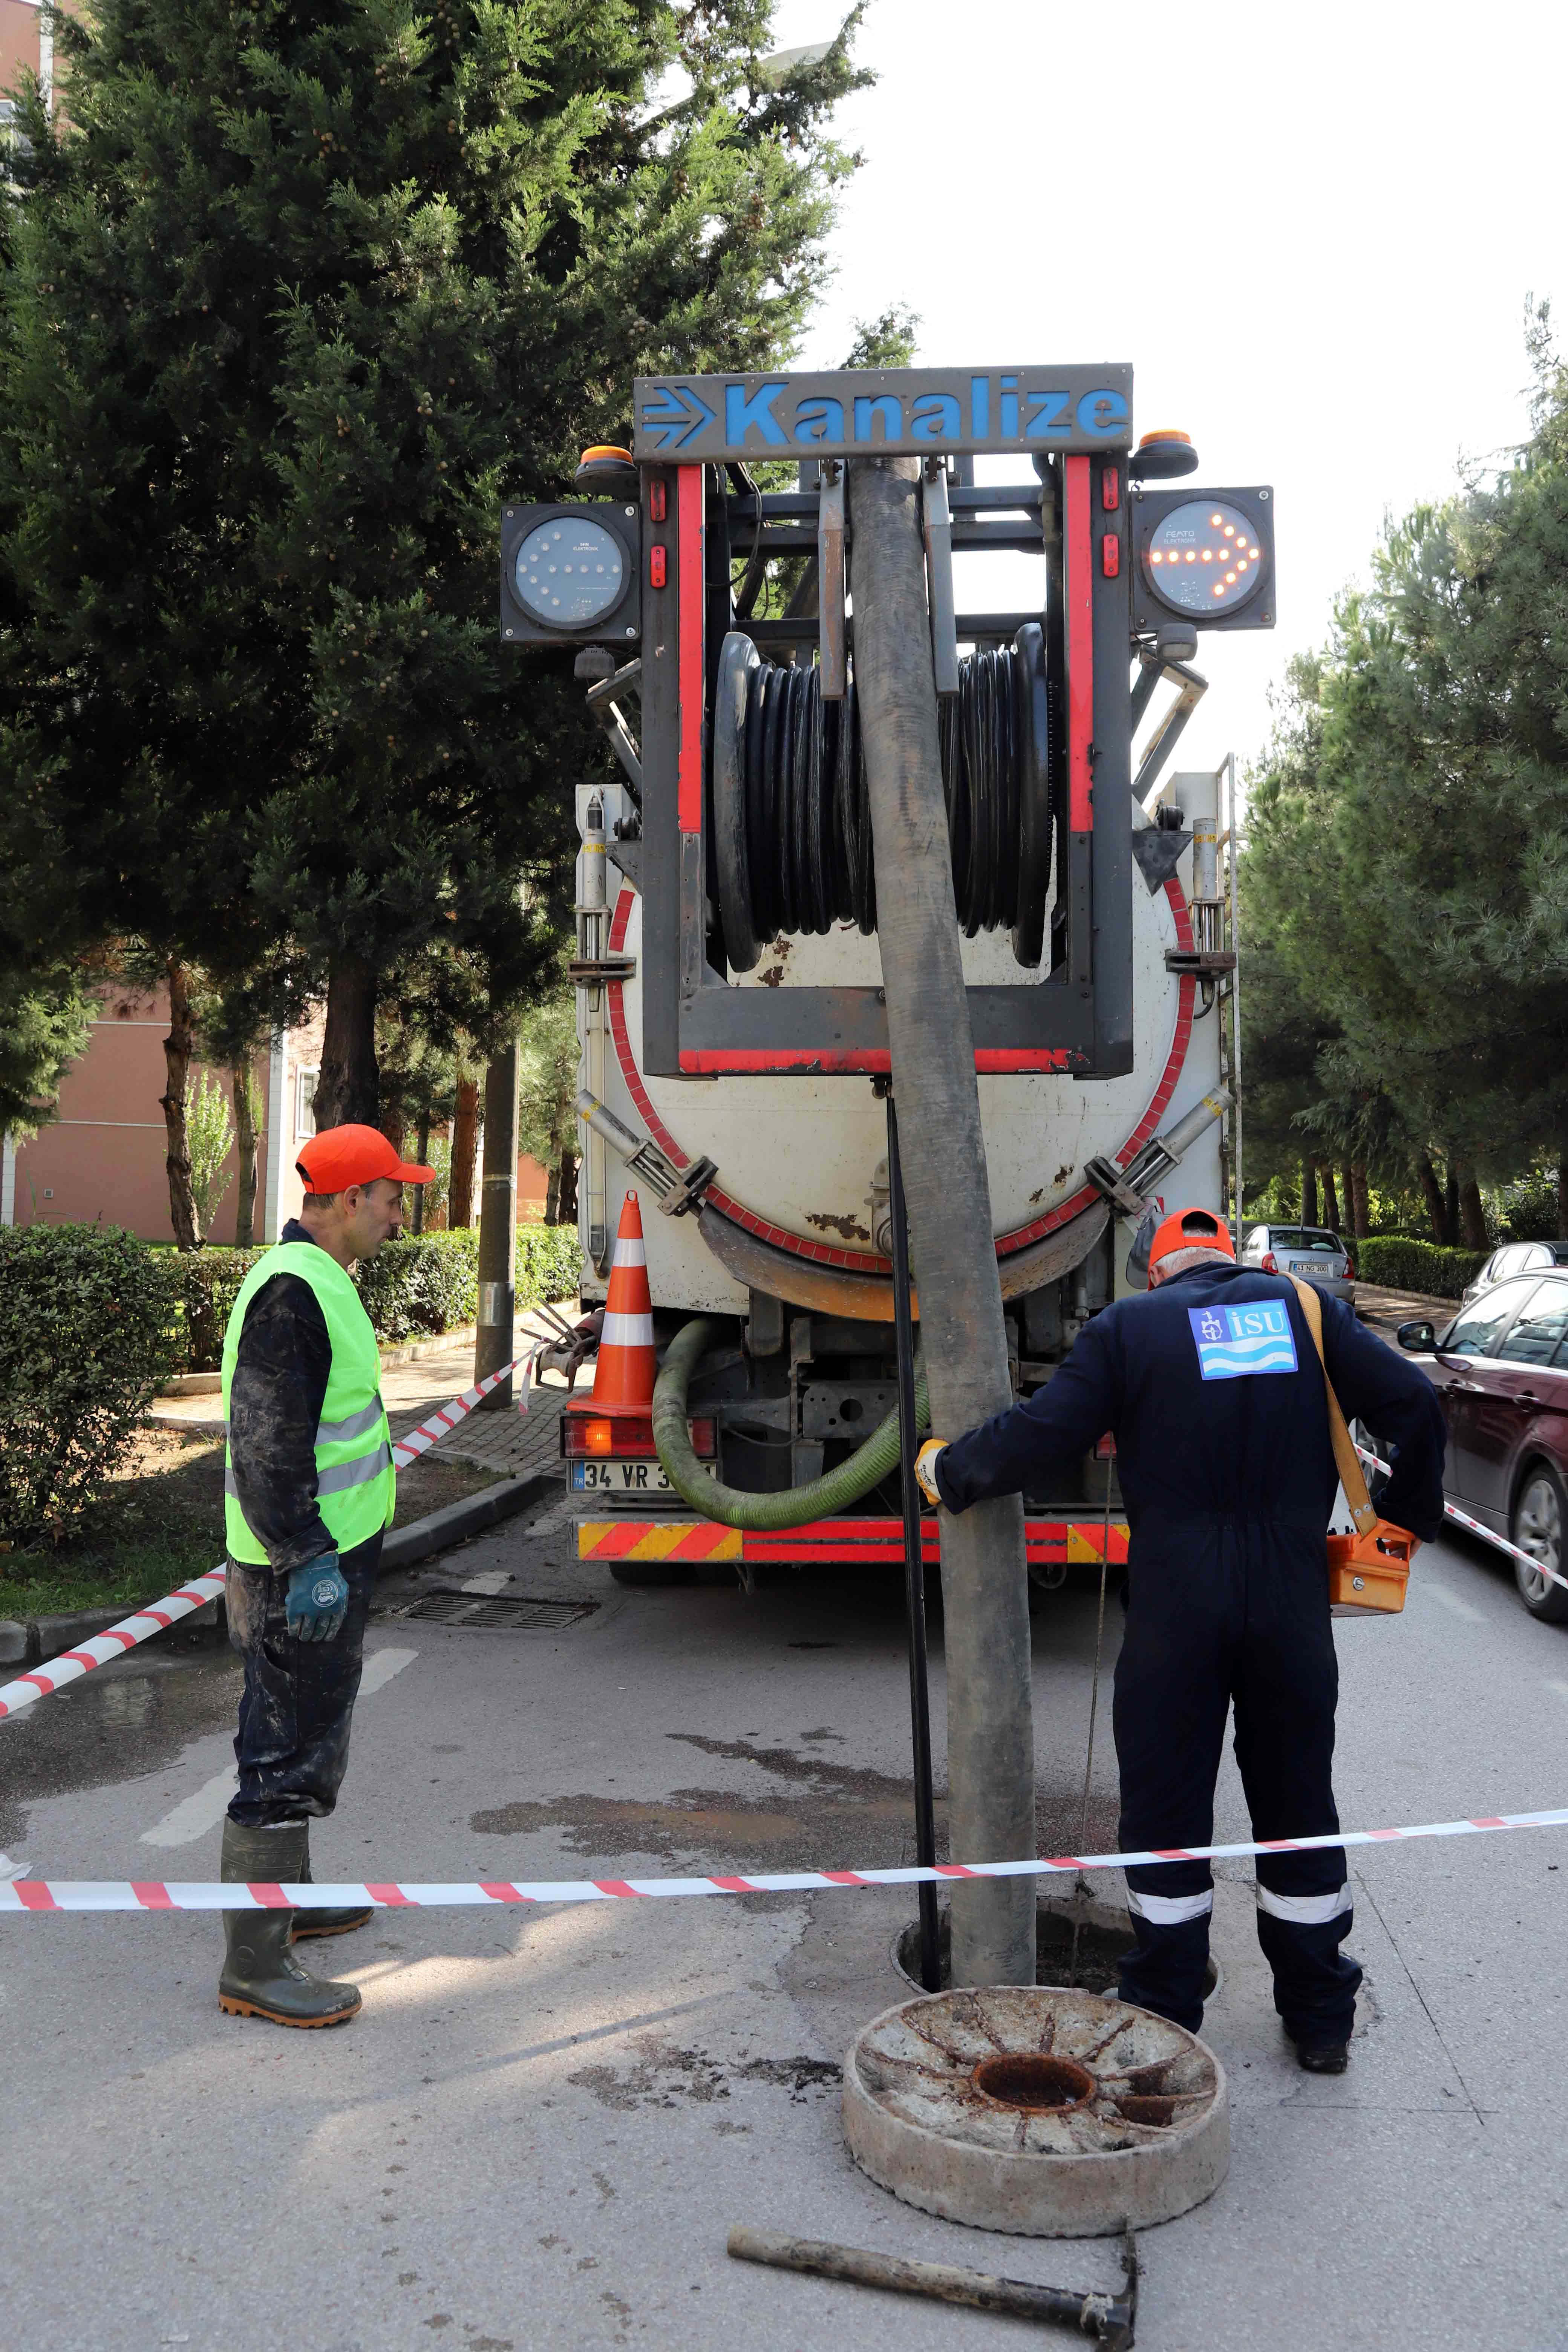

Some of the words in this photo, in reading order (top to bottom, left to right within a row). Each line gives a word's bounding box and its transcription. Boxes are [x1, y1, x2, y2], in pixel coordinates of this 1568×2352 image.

[725, 375, 1129, 446] Kanalize
[585, 1464, 611, 1488] 34
[622, 1465, 648, 1488] VR
